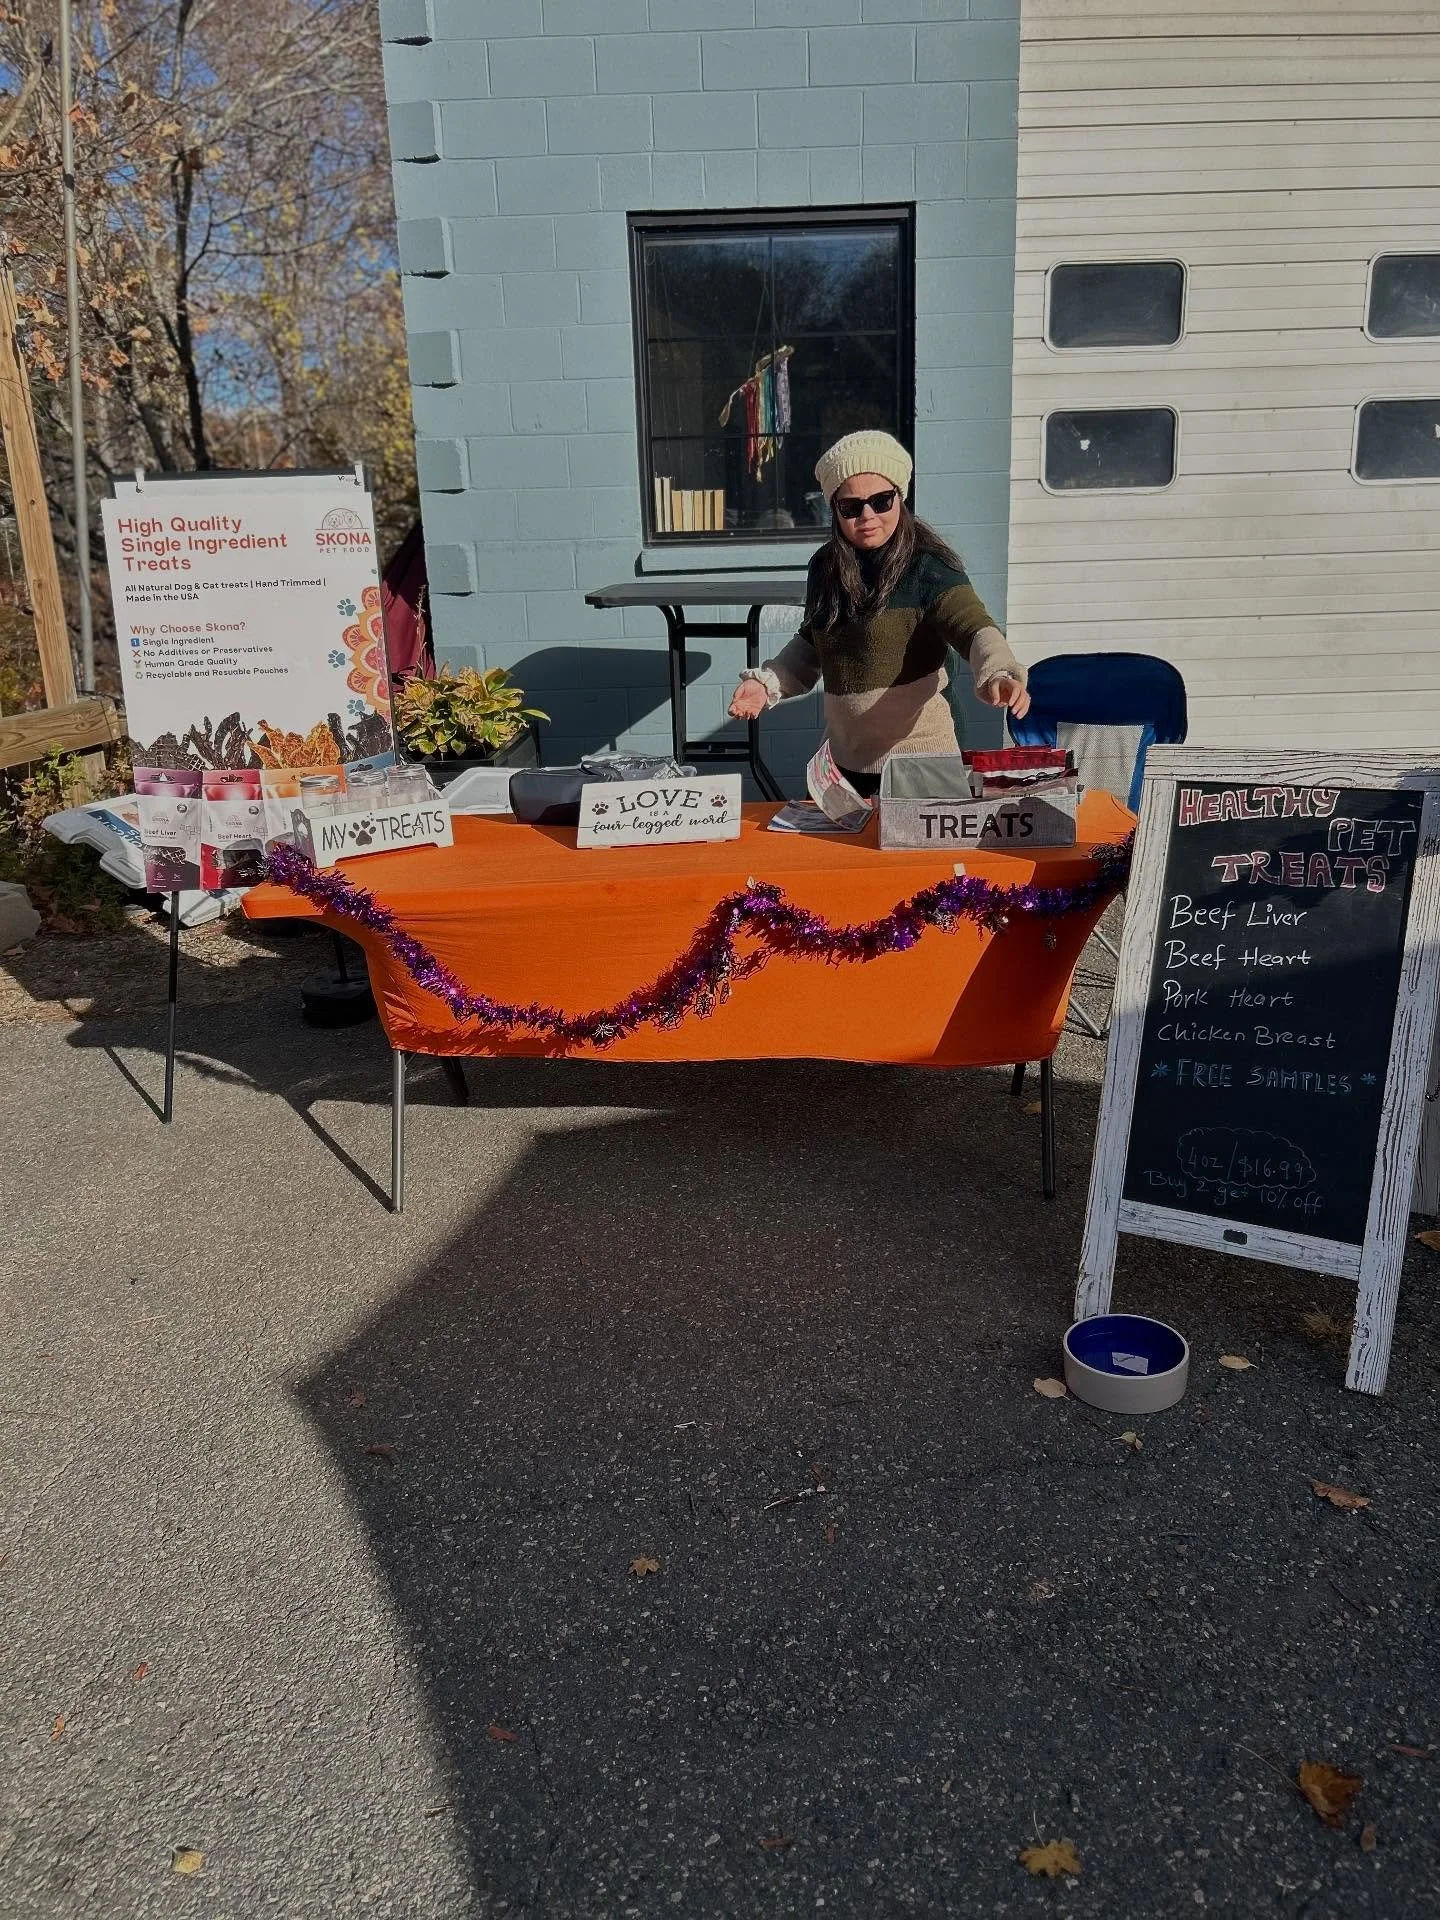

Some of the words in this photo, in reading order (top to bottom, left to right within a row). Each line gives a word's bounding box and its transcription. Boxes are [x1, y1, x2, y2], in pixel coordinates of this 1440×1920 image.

[118, 518, 163, 537] High
[170, 516, 241, 533] Quality
[315, 532, 371, 545] SKONA
[121, 536, 181, 556] Single
[188, 533, 287, 554] Ingredient
[123, 556, 191, 571] Treats
[125, 583, 136, 592] All
[138, 583, 172, 592] Natural
[174, 583, 192, 591] Dog
[194, 582, 200, 590] &
[202, 582, 219, 590] Cat
[221, 581, 249, 589] treats
[255, 580, 279, 588] Hand
[280, 578, 322, 587] Trimmed
[126, 594, 151, 602] Made
[153, 593, 161, 601] in
[163, 593, 179, 601] the
[180, 592, 199, 600] USA
[130, 625, 155, 636] Why
[160, 624, 202, 633] Choose
[206, 621, 246, 631] Skona?
[143, 638, 169, 647] Single
[171, 637, 215, 647] Ingredient
[158, 648, 199, 656] Additives
[213, 646, 273, 654] Preservatives
[144, 660, 175, 668] Human
[177, 659, 204, 667] Grade
[207, 658, 237, 666] Quality
[146, 671, 192, 680] Recyclable
[616, 789, 703, 814] LOVE
[1178, 787, 1341, 827] HEALTHY
[160, 828, 177, 836] Liver
[322, 823, 347, 851] MY
[376, 810, 445, 841] TREATS
[592, 813, 683, 835] four-legged
[689, 810, 729, 825] word
[919, 812, 1034, 839] TREATS
[1328, 817, 1416, 857] PET
[1210, 851, 1390, 893] TREATS
[1169, 894, 1236, 930] Beef
[1247, 902, 1307, 927] Liver
[1164, 940, 1226, 970] Beef
[1238, 947, 1312, 968] Heart
[1163, 979, 1209, 1013] Pork
[1229, 987, 1294, 1008] Heart
[1157, 1022, 1246, 1042] Chicken
[1253, 1025, 1336, 1049] Breast
[1176, 1058, 1233, 1088] FREE
[1246, 1066, 1353, 1095] SAMPLES
[1143, 1170, 1187, 1198] Buy
[1196, 1180, 1209, 1192] 2
[1213, 1185, 1249, 1206] get
[1260, 1188, 1288, 1209] 10%
[1293, 1191, 1323, 1214] off
